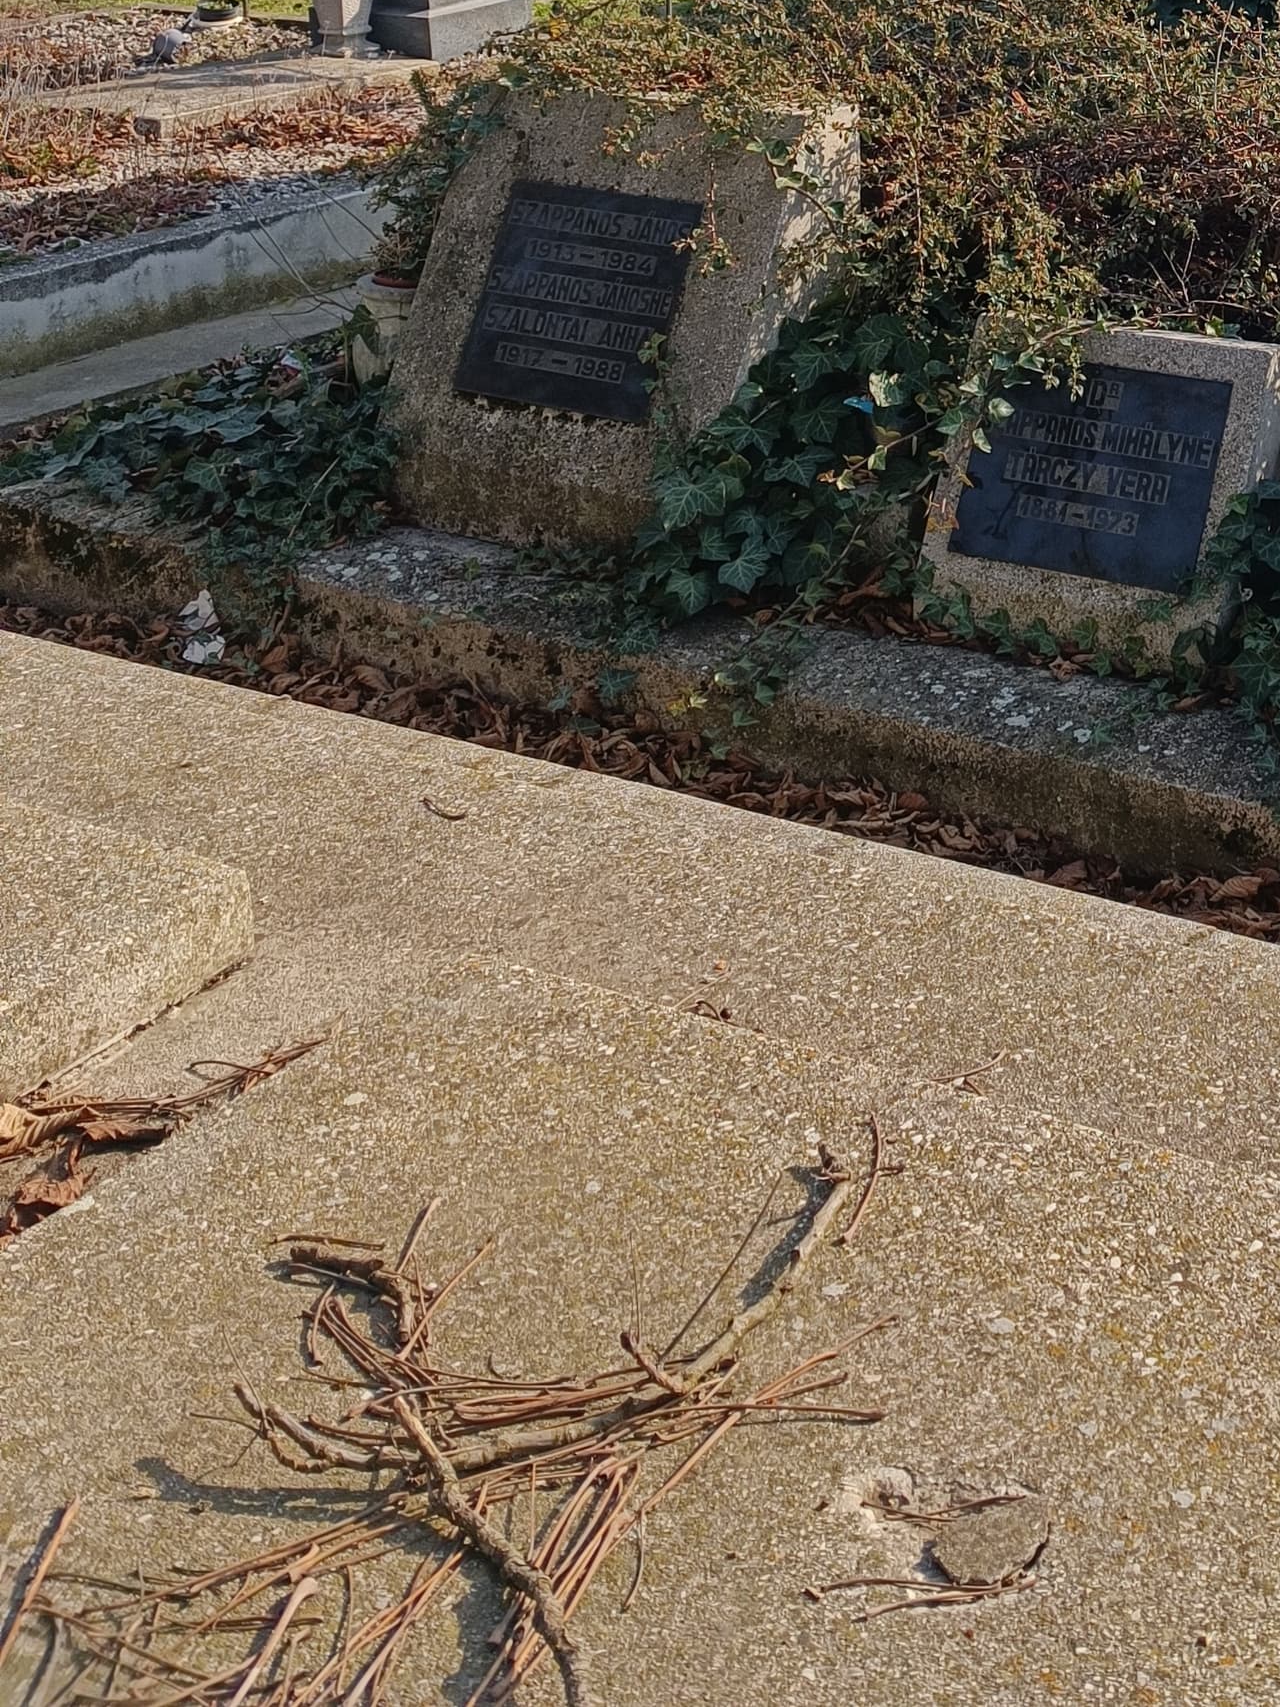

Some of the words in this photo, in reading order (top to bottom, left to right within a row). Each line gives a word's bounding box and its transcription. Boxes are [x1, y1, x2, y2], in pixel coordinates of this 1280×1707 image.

[511, 200, 626, 238] SZAPPANOS
[600, 250, 654, 275] 1984
[489, 267, 595, 305] SZAPPANOS
[484, 306, 590, 342] SZALONTAI
[574, 357, 624, 382] 1988
[1000, 407, 1098, 448] APPANOS
[1105, 467, 1170, 503] VERA
